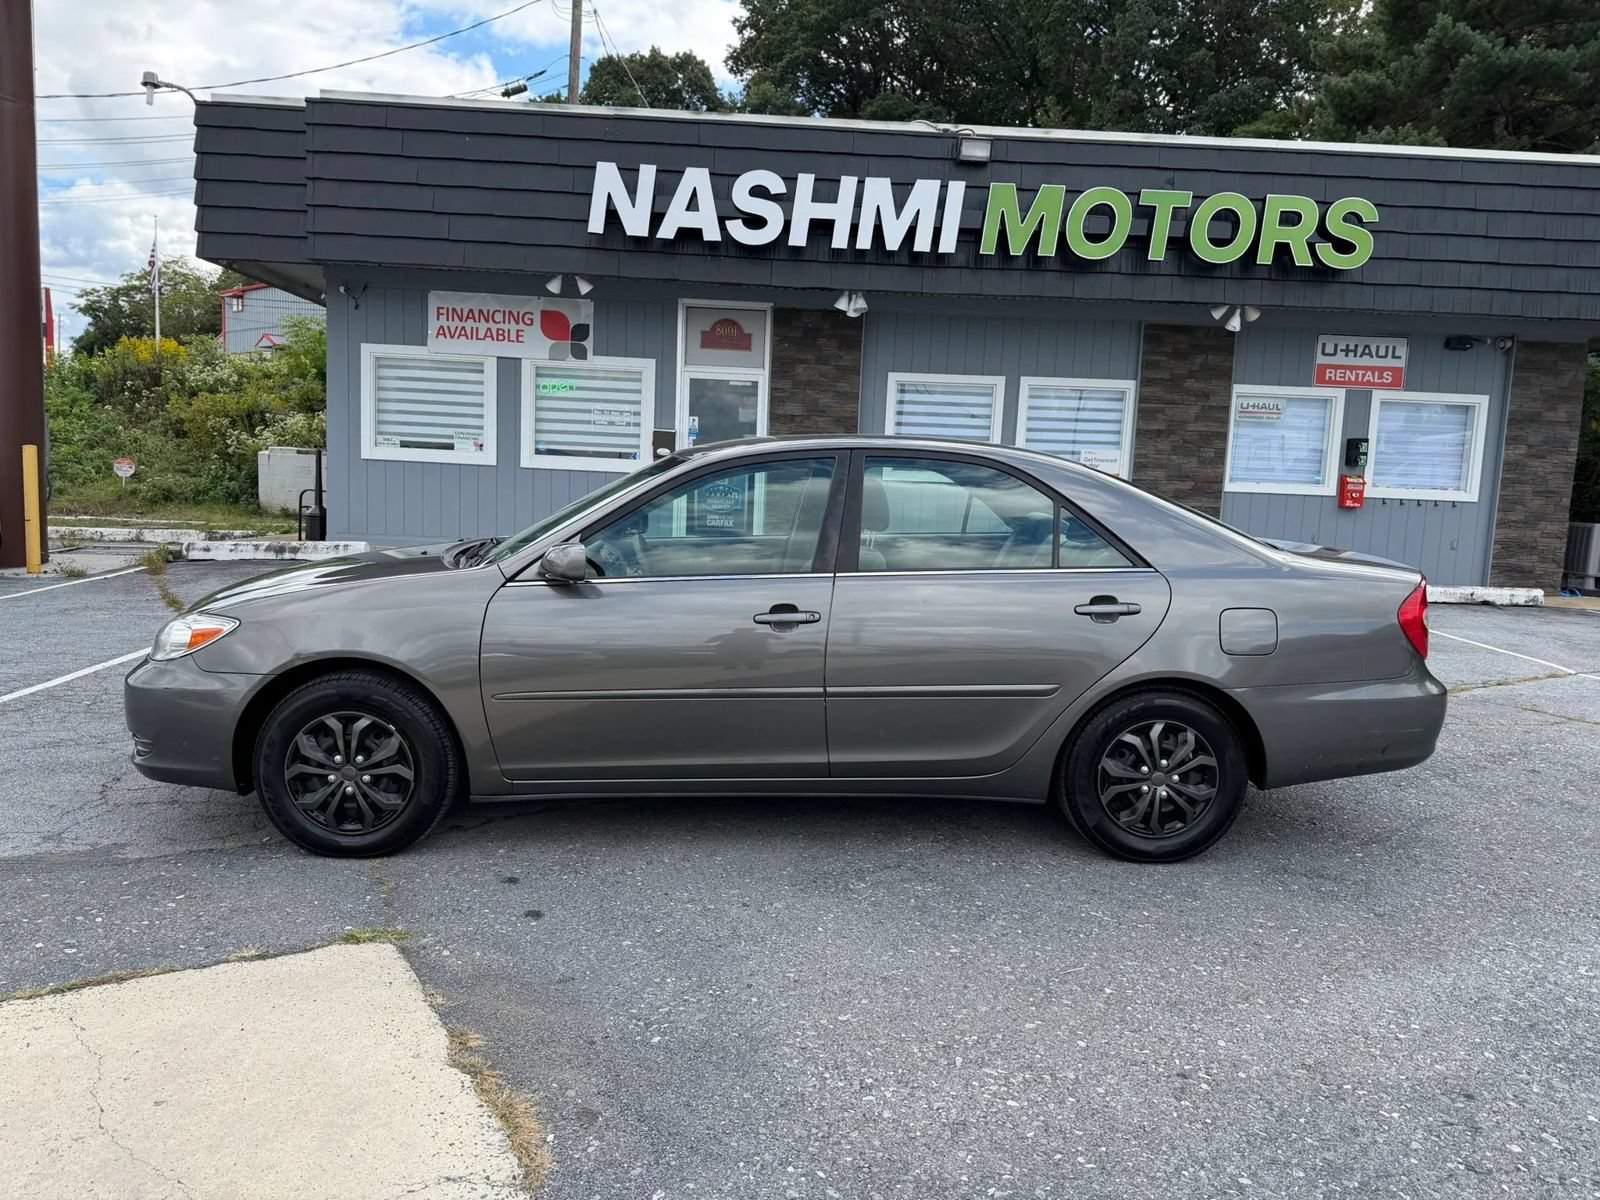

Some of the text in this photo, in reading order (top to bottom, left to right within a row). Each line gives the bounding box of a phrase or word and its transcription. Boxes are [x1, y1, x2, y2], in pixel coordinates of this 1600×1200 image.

[587, 161, 1379, 269] NASHMI MOTORS
[436, 306, 534, 326] FINANCING
[435, 325, 525, 343] AVAILABLE
[715, 325, 737, 337] 8001
[1320, 342, 1402, 360] U-HAUL
[1325, 369, 1392, 383] RENTALS
[1240, 402, 1281, 411] U-HAUL
[706, 519, 734, 527] CARFAX
